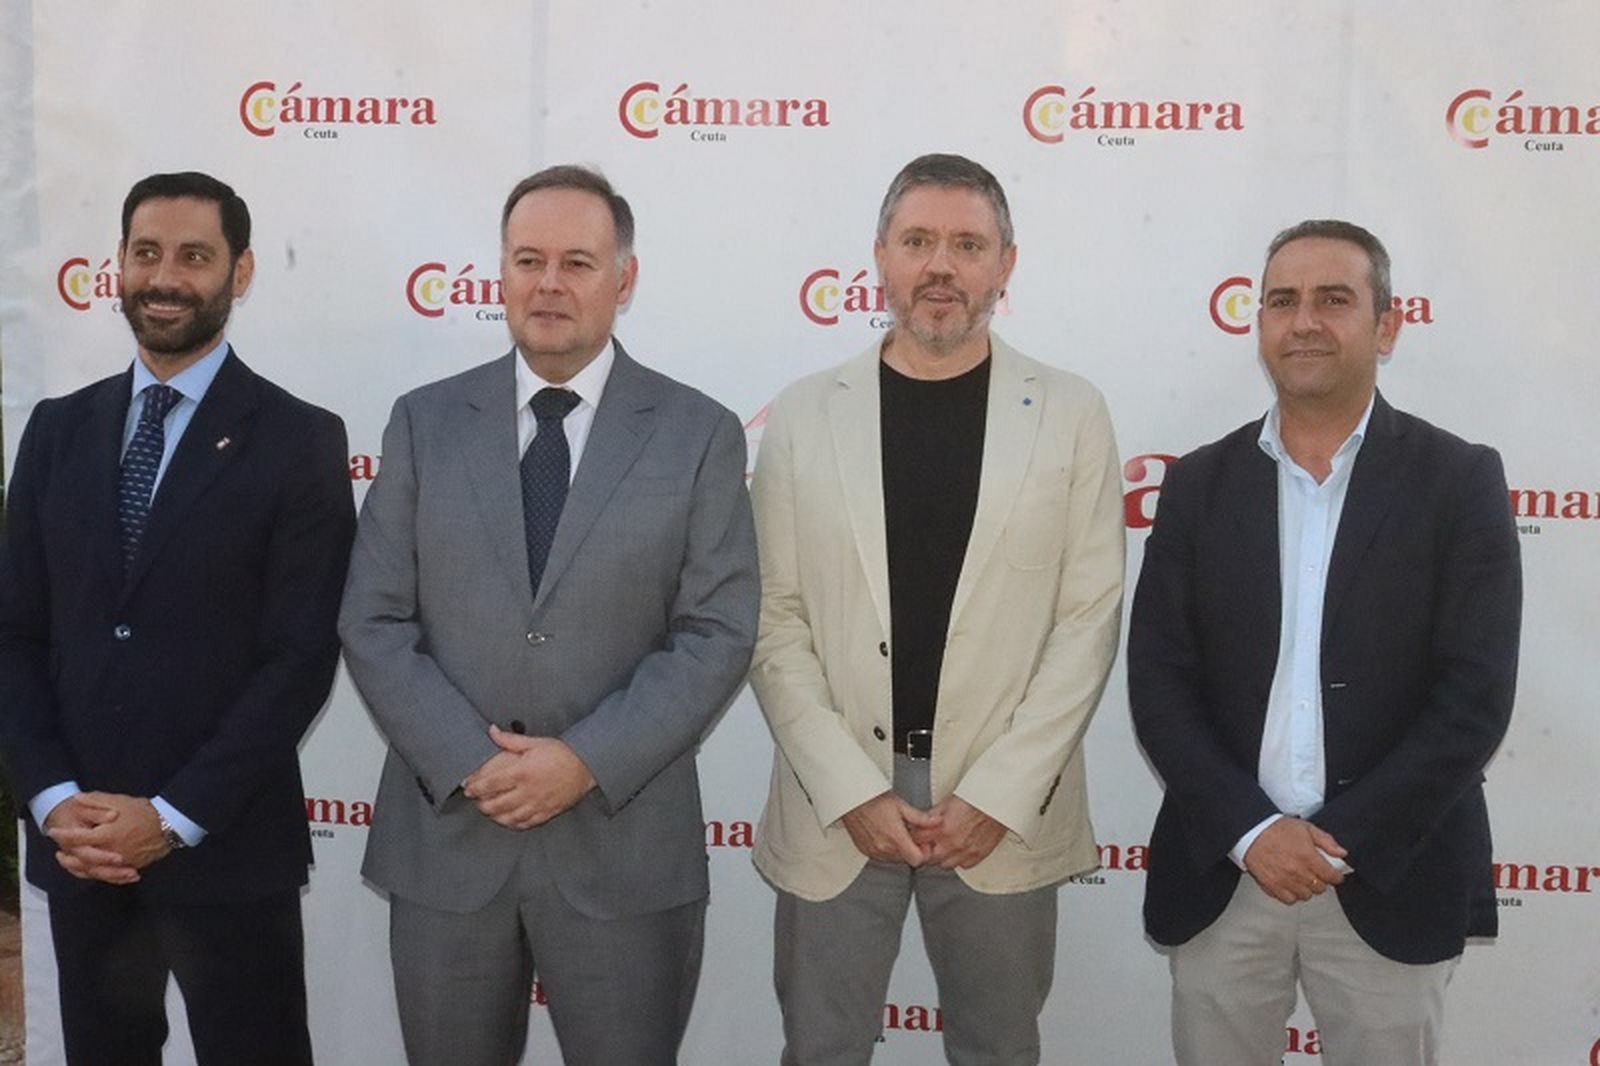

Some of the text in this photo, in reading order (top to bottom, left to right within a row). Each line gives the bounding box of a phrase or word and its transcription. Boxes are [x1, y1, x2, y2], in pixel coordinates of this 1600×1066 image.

[303, 127, 338, 139] Ceuta
[691, 130, 727, 141] Ceuta
[1097, 134, 1135, 146] Ceuta
[1524, 139, 1564, 151] Ceuta
